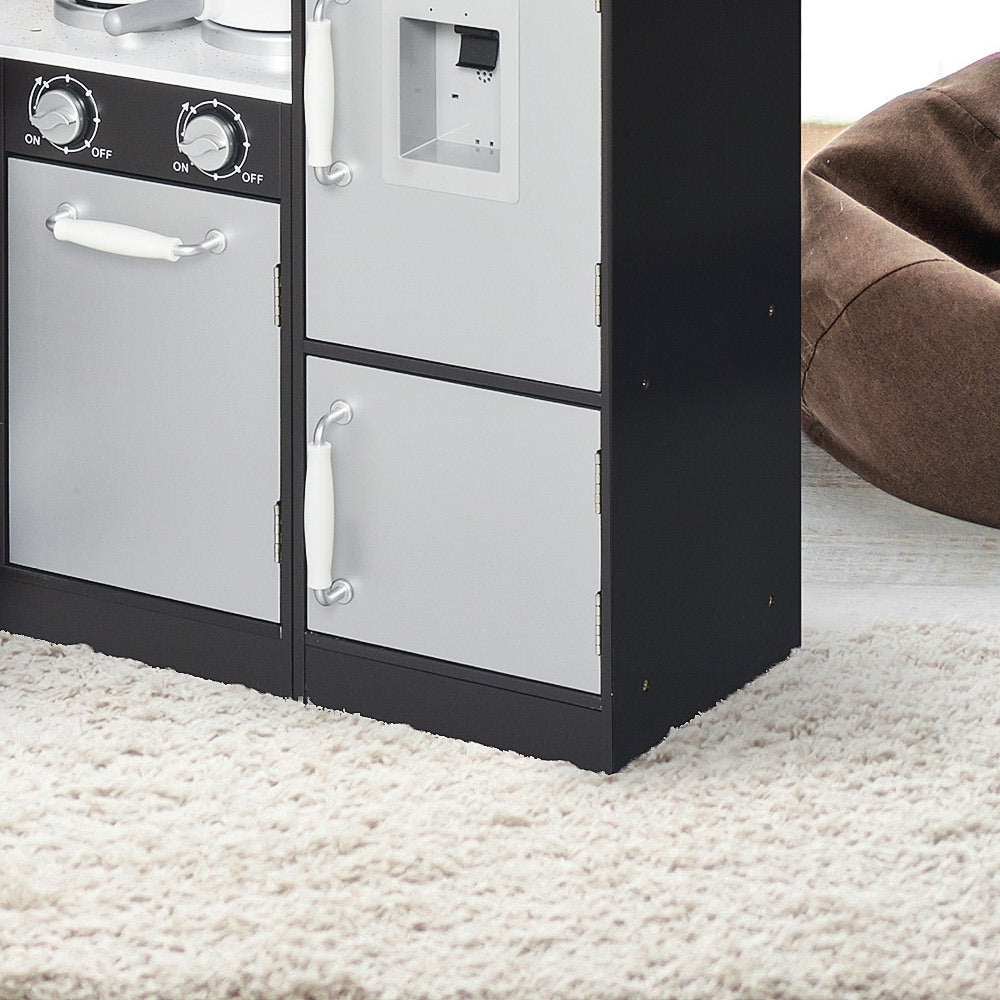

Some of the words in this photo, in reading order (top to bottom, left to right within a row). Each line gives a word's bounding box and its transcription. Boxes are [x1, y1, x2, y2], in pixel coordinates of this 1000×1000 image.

[24, 134, 41, 146] ON
[91, 147, 113, 160] OFF
[173, 161, 189, 173] ON
[241, 172, 264, 185] OFF
